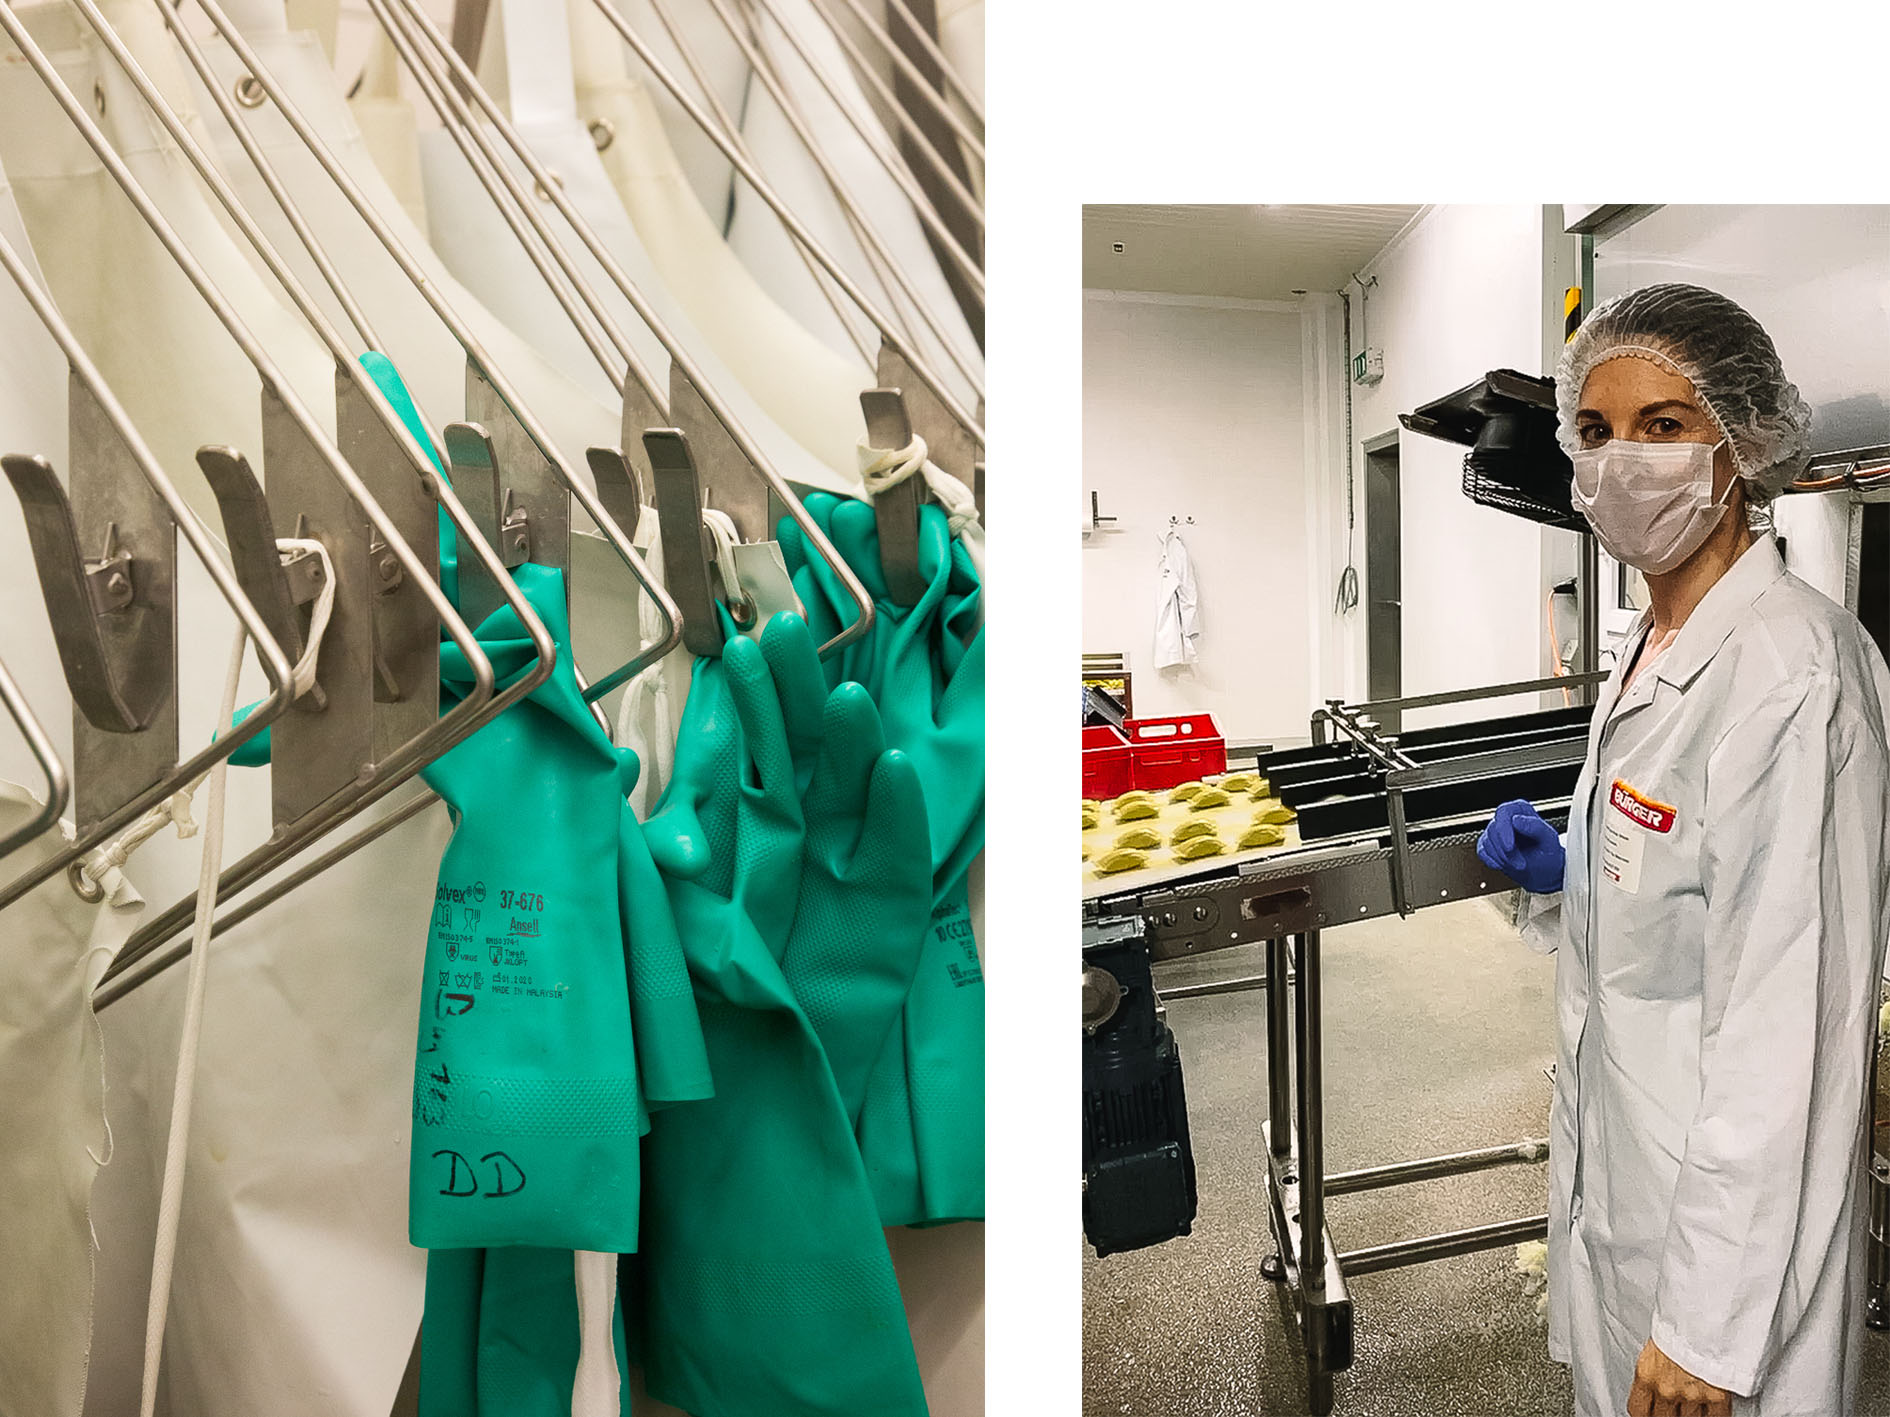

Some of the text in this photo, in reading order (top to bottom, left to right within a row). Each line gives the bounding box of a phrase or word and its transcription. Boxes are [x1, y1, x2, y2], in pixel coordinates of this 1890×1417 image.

[1614, 788, 1663, 827] BÜRGER
[500, 890, 544, 911] 37-676
[510, 916, 539, 932] Ansell
[492, 985, 563, 999] MADE IN MALAYSIA
